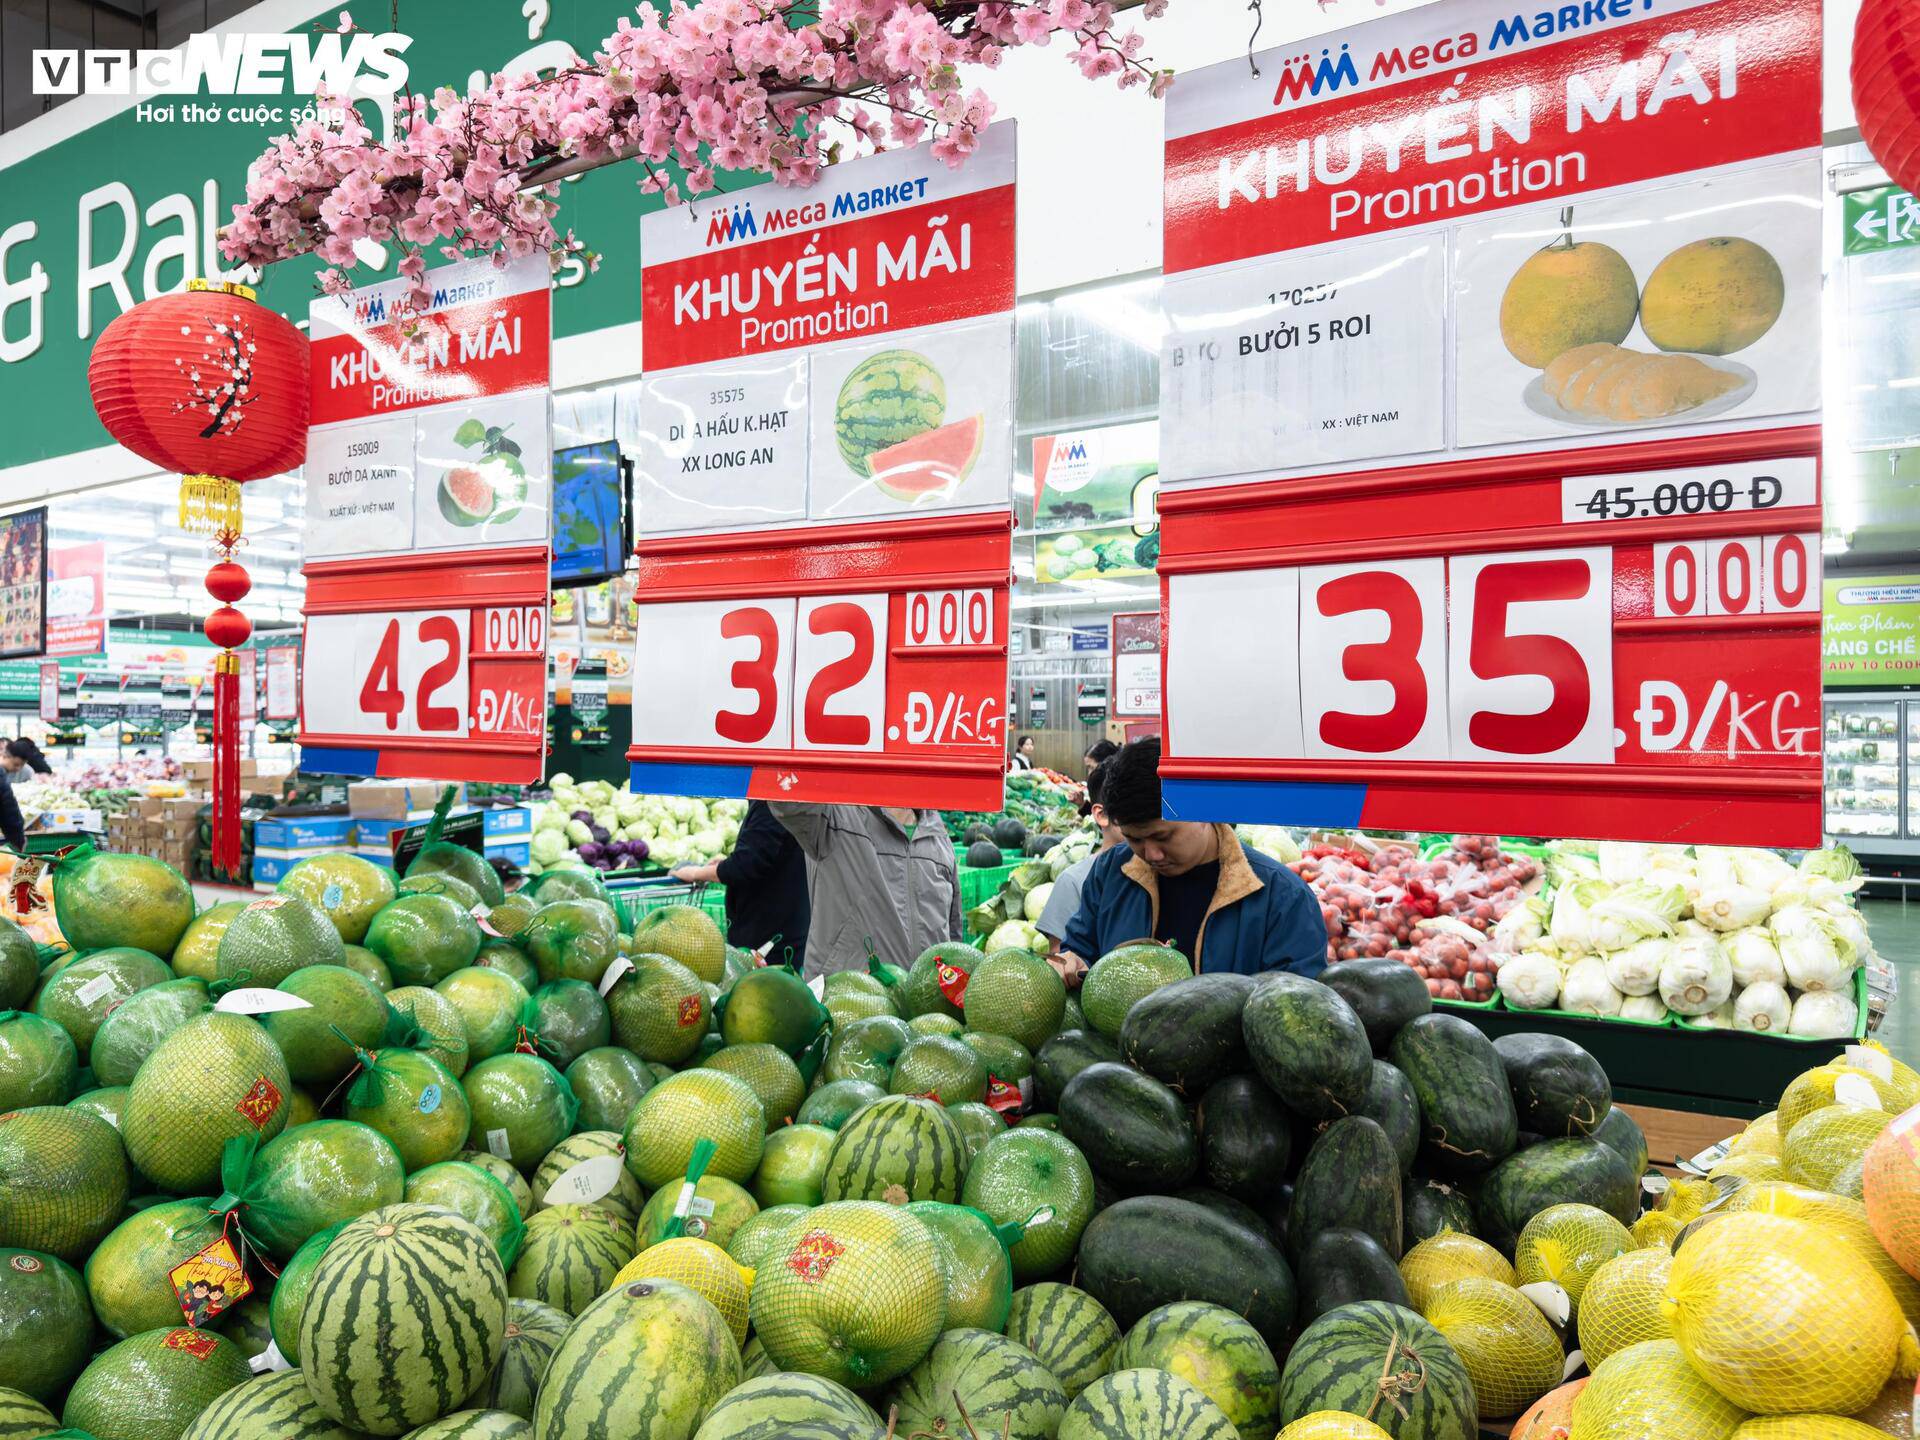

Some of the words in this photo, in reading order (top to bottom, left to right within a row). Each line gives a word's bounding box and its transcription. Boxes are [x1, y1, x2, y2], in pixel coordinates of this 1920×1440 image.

[1216, 70, 1532, 210] KHUYẾN
[1565, 30, 1739, 134] MÃI
[1328, 150, 1587, 232] Promotion
[673, 232, 858, 326] KHUYẾN
[875, 214, 972, 288] MÃI
[459, 310, 521, 364] MÃI
[741, 300, 889, 348] Promotion
[1239, 320, 1300, 357] BƯỞI
[1308, 323, 1322, 345] 5
[1329, 314, 1372, 342] ROI
[709, 388, 745, 405] 35575
[1322, 419, 1337, 430] XX
[1344, 414, 1369, 428] VIỆT
[1371, 410, 1400, 424] NAM
[347, 440, 380, 458] 159009
[669, 422, 703, 442] DA
[707, 411, 740, 437] HẤU
[744, 410, 789, 433] K.HẠT
[682, 455, 701, 474] XX
[705, 450, 746, 471] LONG
[750, 447, 774, 466] AN
[378, 501, 396, 512] NAM
[1584, 478, 1735, 521] 45.000
[1747, 475, 1784, 508] Đ
[1664, 533, 1807, 616] 000
[489, 607, 542, 651] 000
[910, 591, 987, 645] 000
[1315, 557, 1594, 756] 35
[1875, 634, 1917, 655] CHẾ
[359, 615, 461, 732] 42
[714, 601, 875, 746] 32
